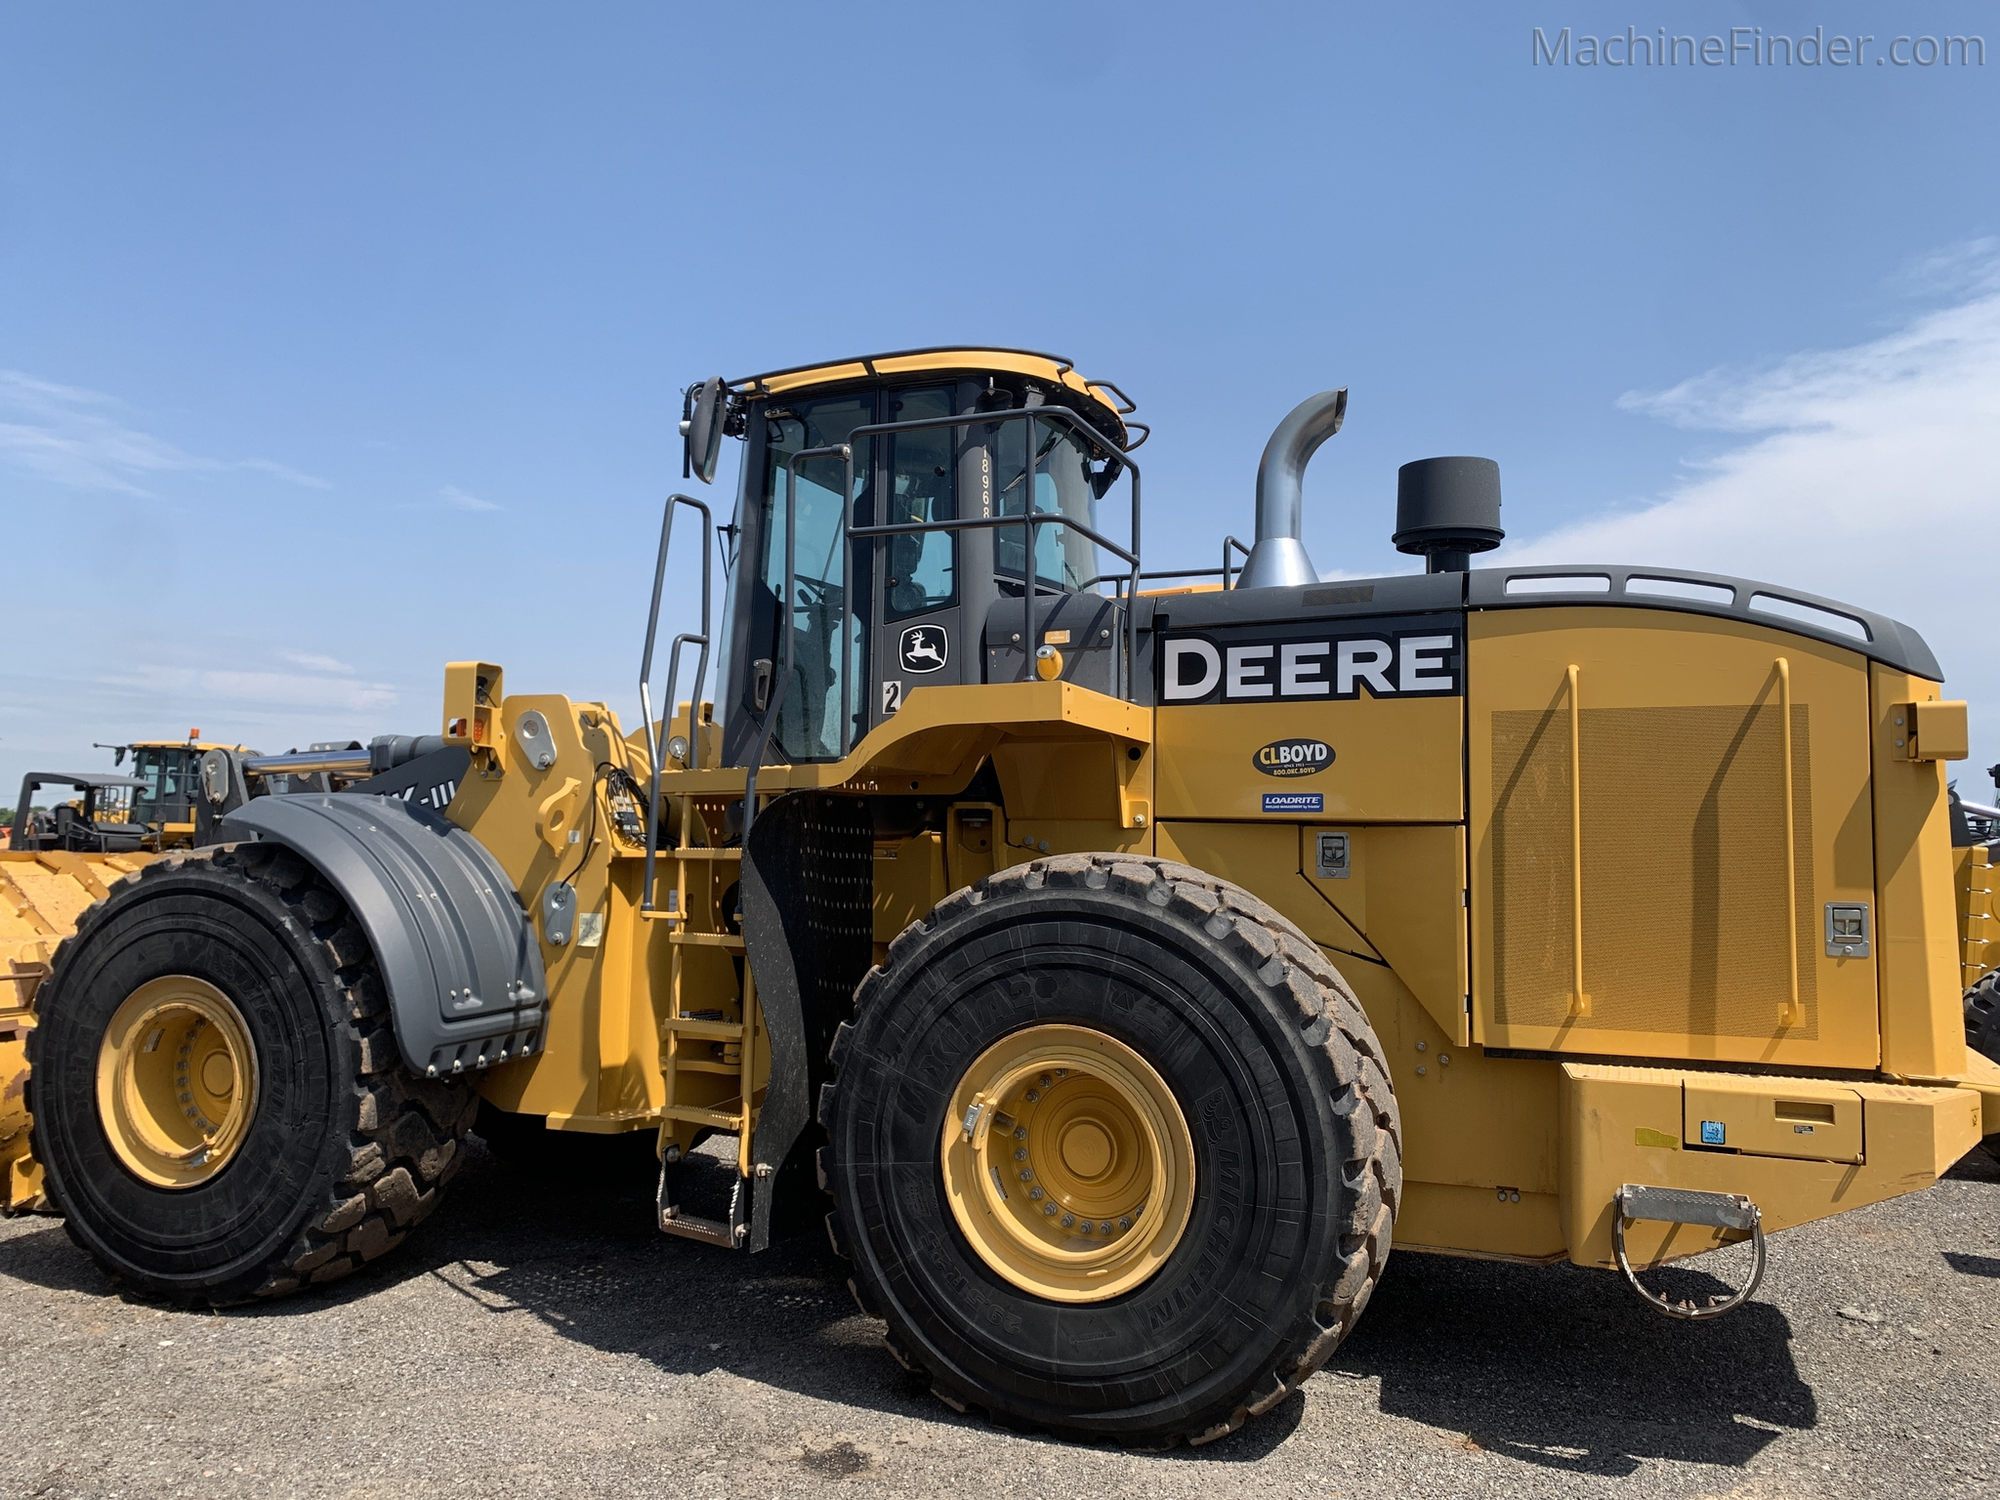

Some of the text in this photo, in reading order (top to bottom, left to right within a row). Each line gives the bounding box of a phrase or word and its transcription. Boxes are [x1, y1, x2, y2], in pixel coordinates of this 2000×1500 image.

[1164, 635, 1453, 699] DEERE
[885, 682, 899, 713] 2
[1260, 744, 1327, 765] CLBOYD
[1148, 1148, 1241, 1332] MICHELIN
